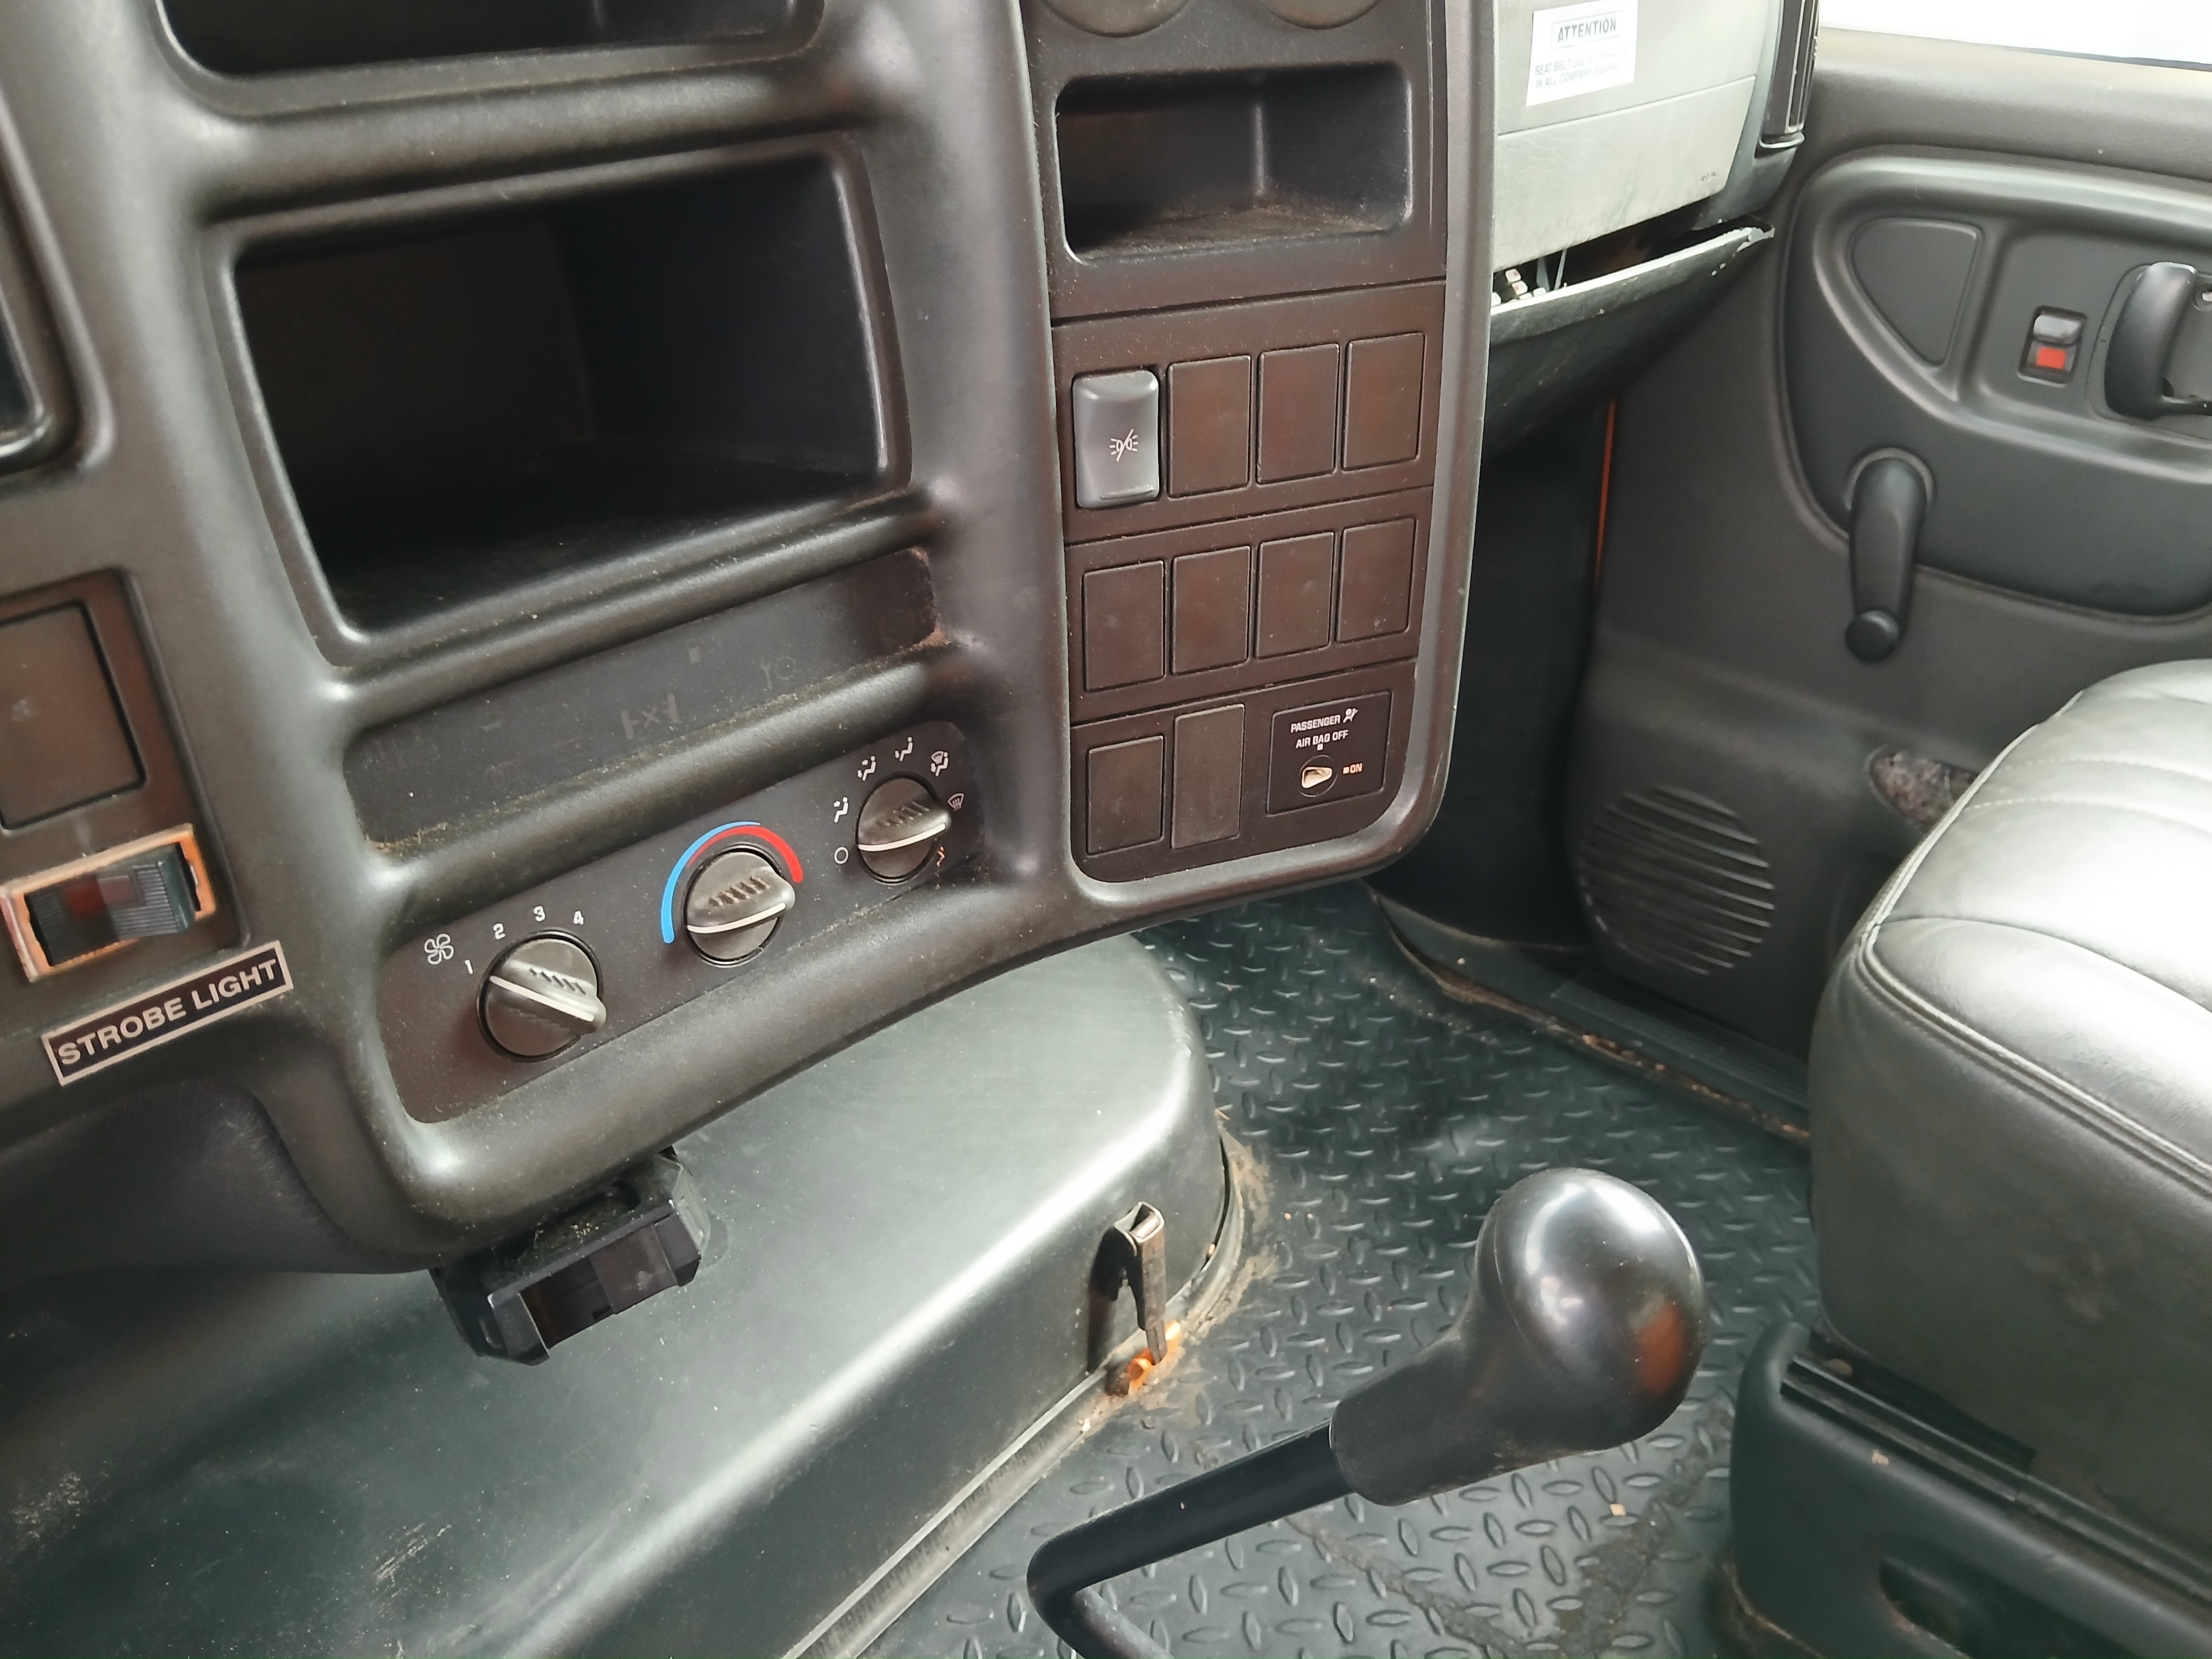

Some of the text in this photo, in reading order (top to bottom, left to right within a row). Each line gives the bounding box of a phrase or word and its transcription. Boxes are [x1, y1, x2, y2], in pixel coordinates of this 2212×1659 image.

[1557, 17, 1617, 43] ATTENTION
[1535, 56, 1585, 76] SEAT BELT USE
[1535, 78, 1543, 89] IN
[1545, 76, 1557, 86] ALL
[1559, 68, 1592, 84] COMPANY
[1290, 714, 1341, 733] PASSENGER
[1295, 729, 1349, 749] AIR BAG OFF
[1349, 763, 1362, 773] ON
[533, 905, 545, 922] 3
[573, 910, 584, 925] 4
[493, 923, 505, 940] 2
[464, 959, 473, 975] 1
[58, 959, 276, 1065] STROBE LIGHT
